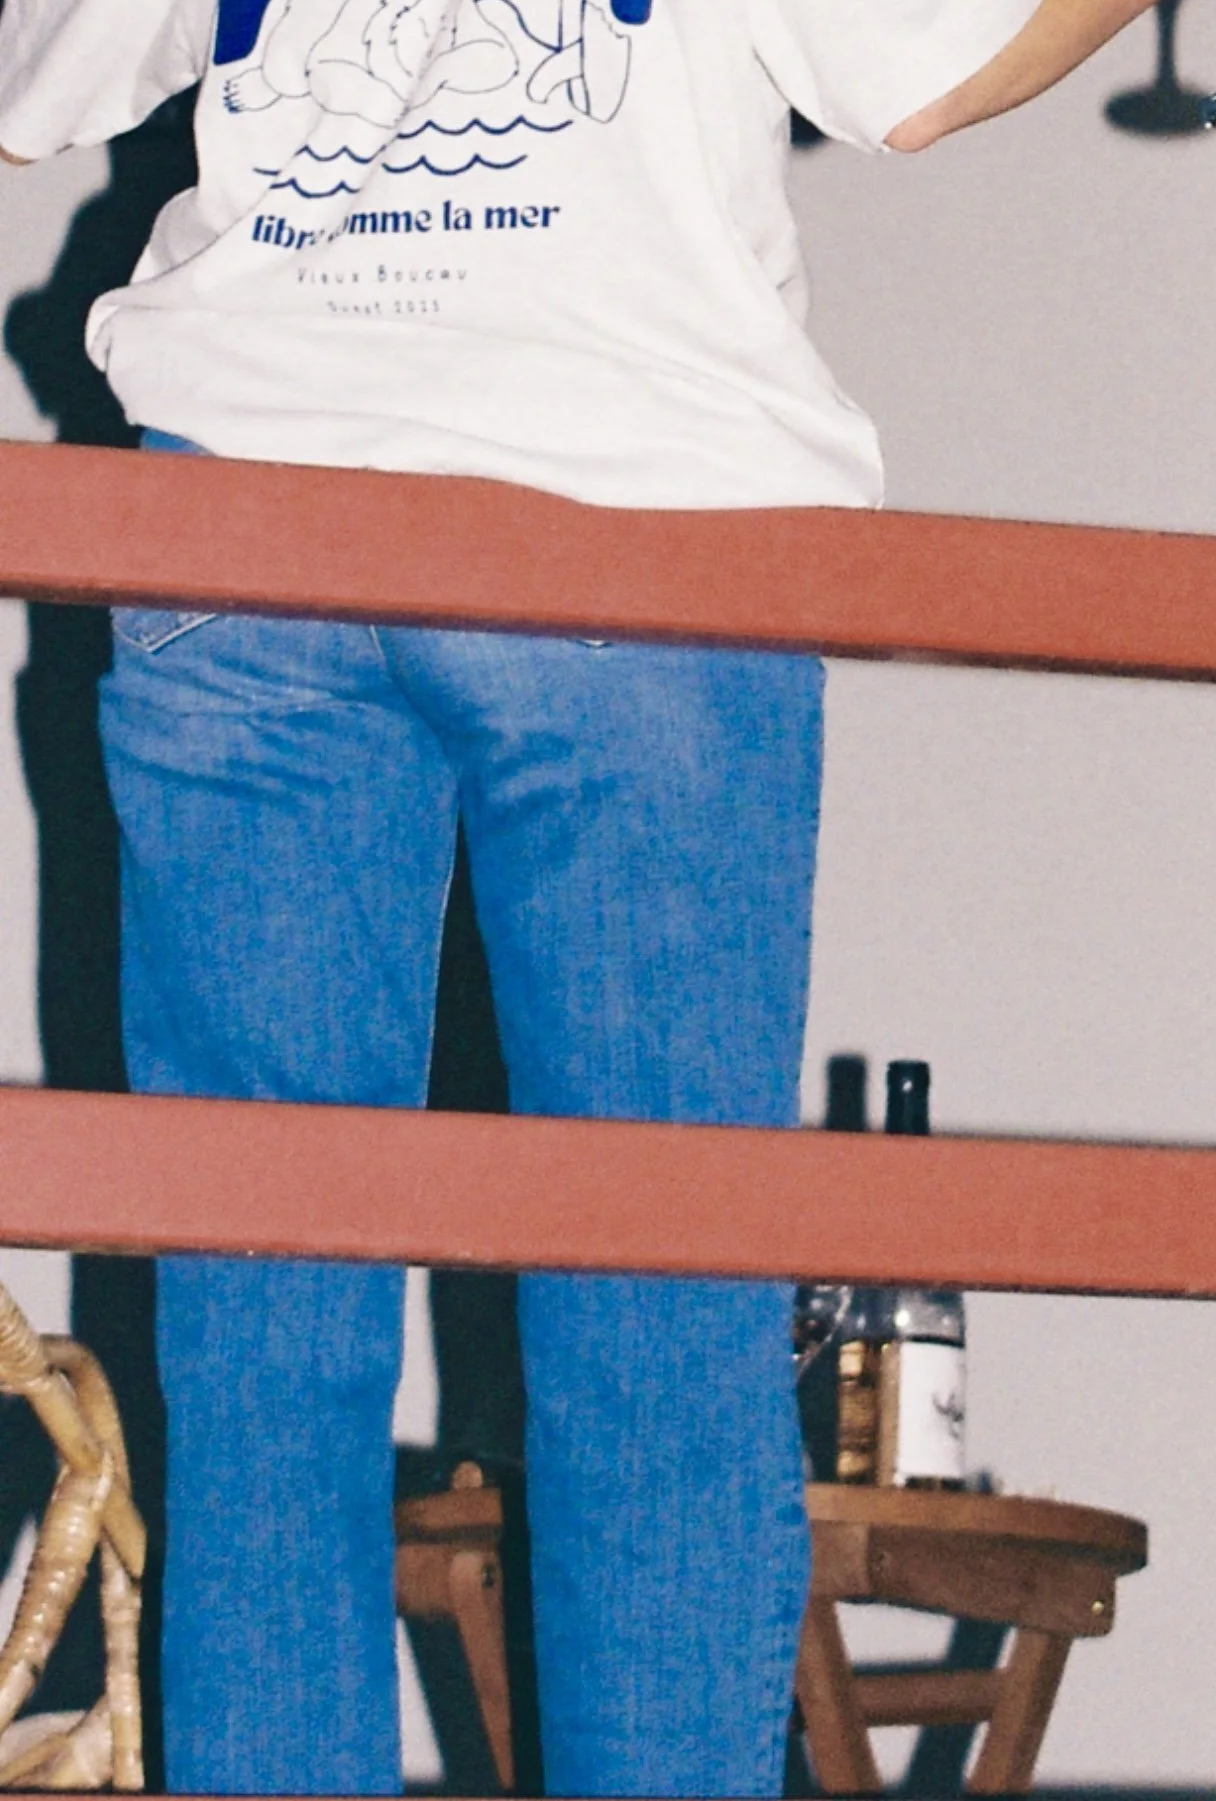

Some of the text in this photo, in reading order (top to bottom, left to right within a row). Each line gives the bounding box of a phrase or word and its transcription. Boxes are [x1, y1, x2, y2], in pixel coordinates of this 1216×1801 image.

[327, 205, 432, 242] mme
[442, 200, 473, 231] la
[484, 204, 561, 230] mer
